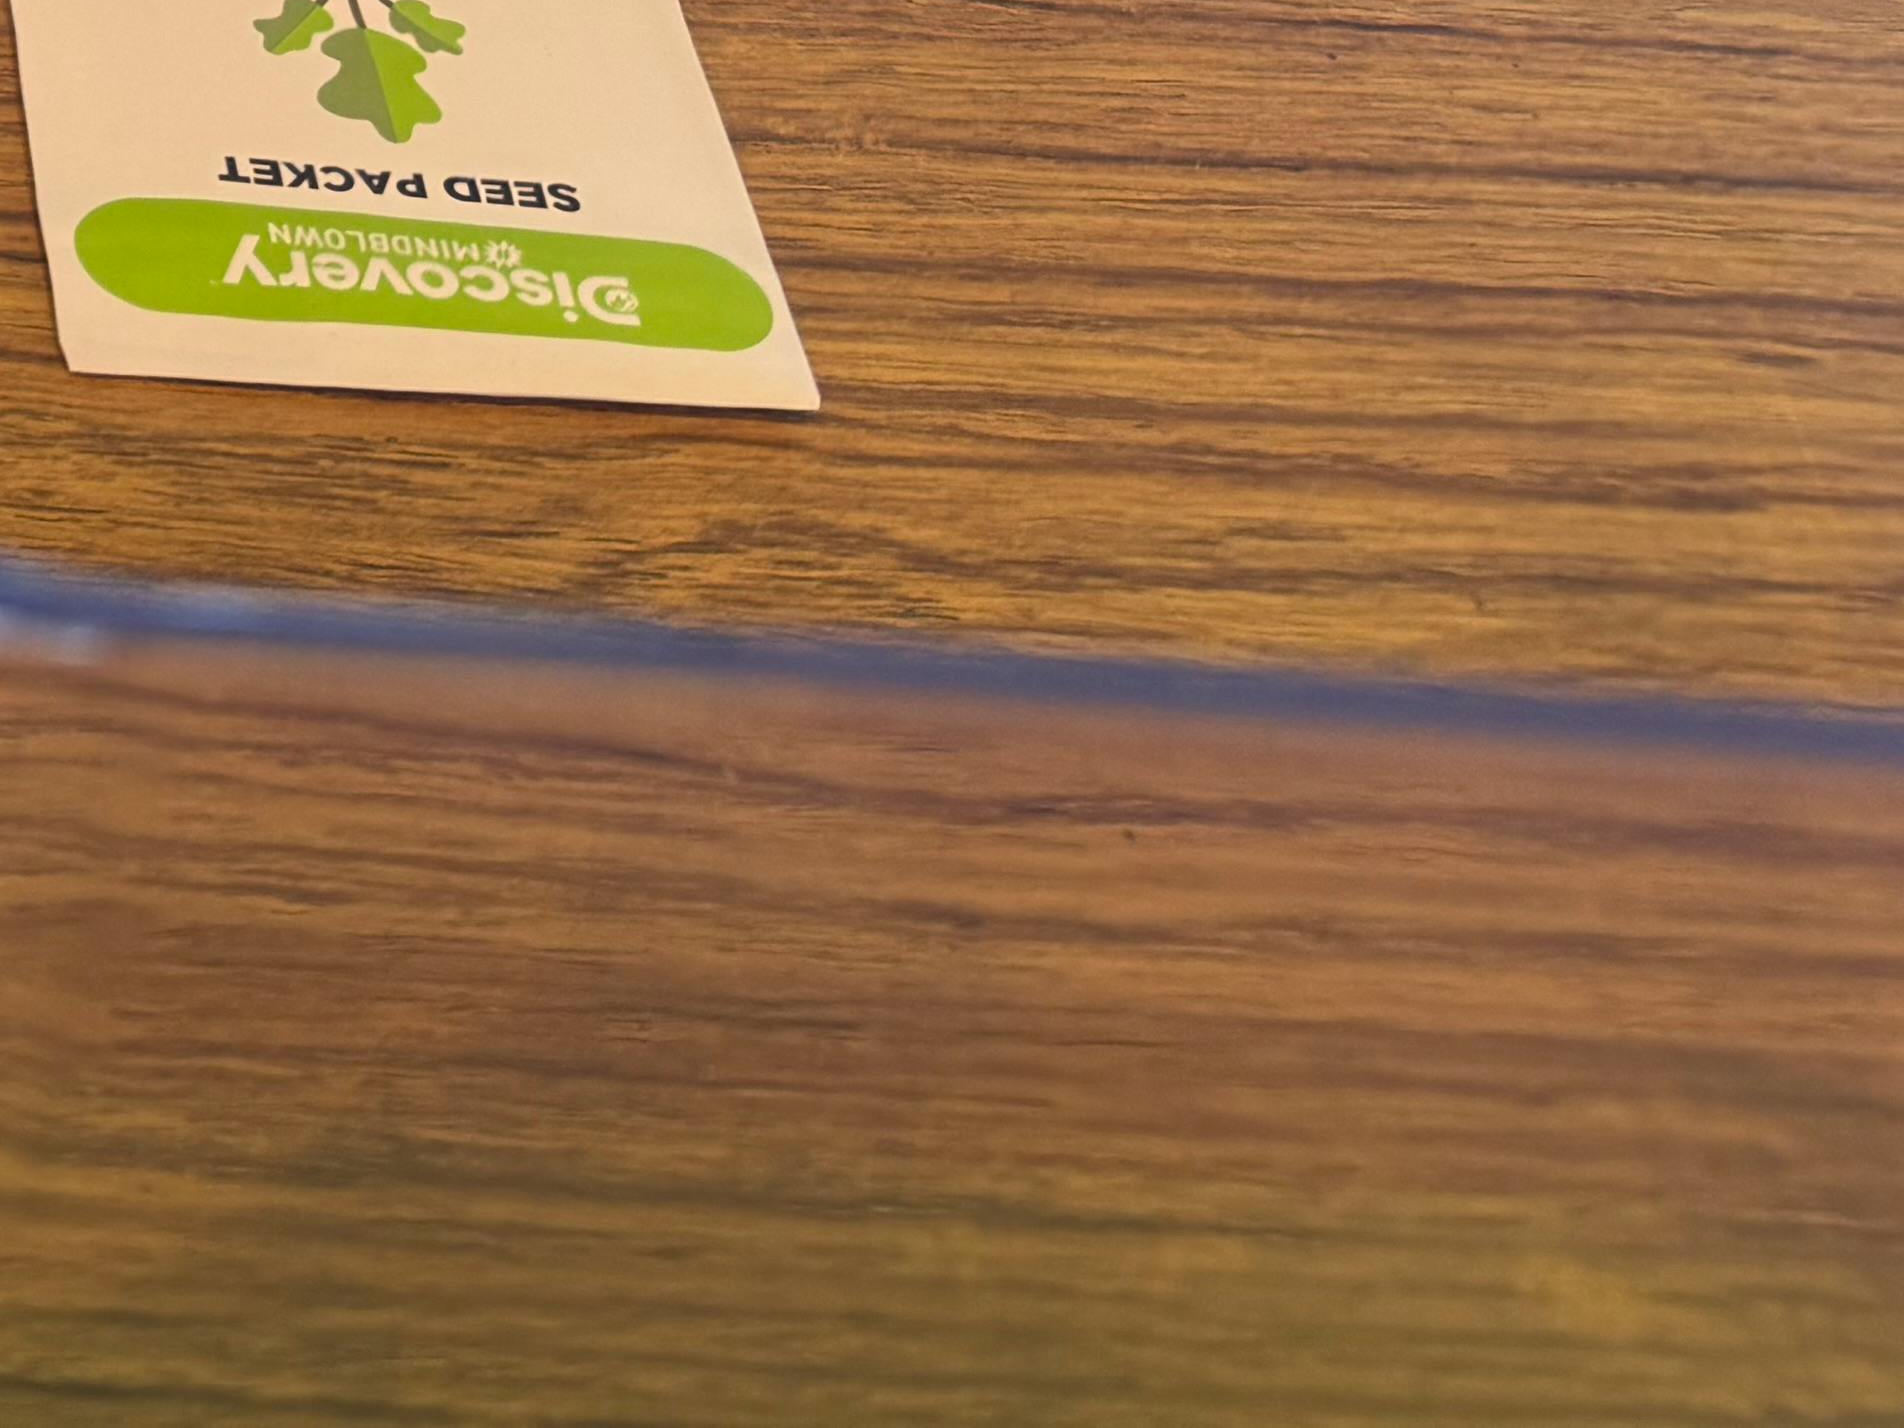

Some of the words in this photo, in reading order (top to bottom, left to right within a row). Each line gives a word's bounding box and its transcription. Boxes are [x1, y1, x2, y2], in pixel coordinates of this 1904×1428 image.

[218, 156, 424, 199] PACKET
[443, 176, 581, 212] SEED
[219, 234, 641, 326] Discovery
